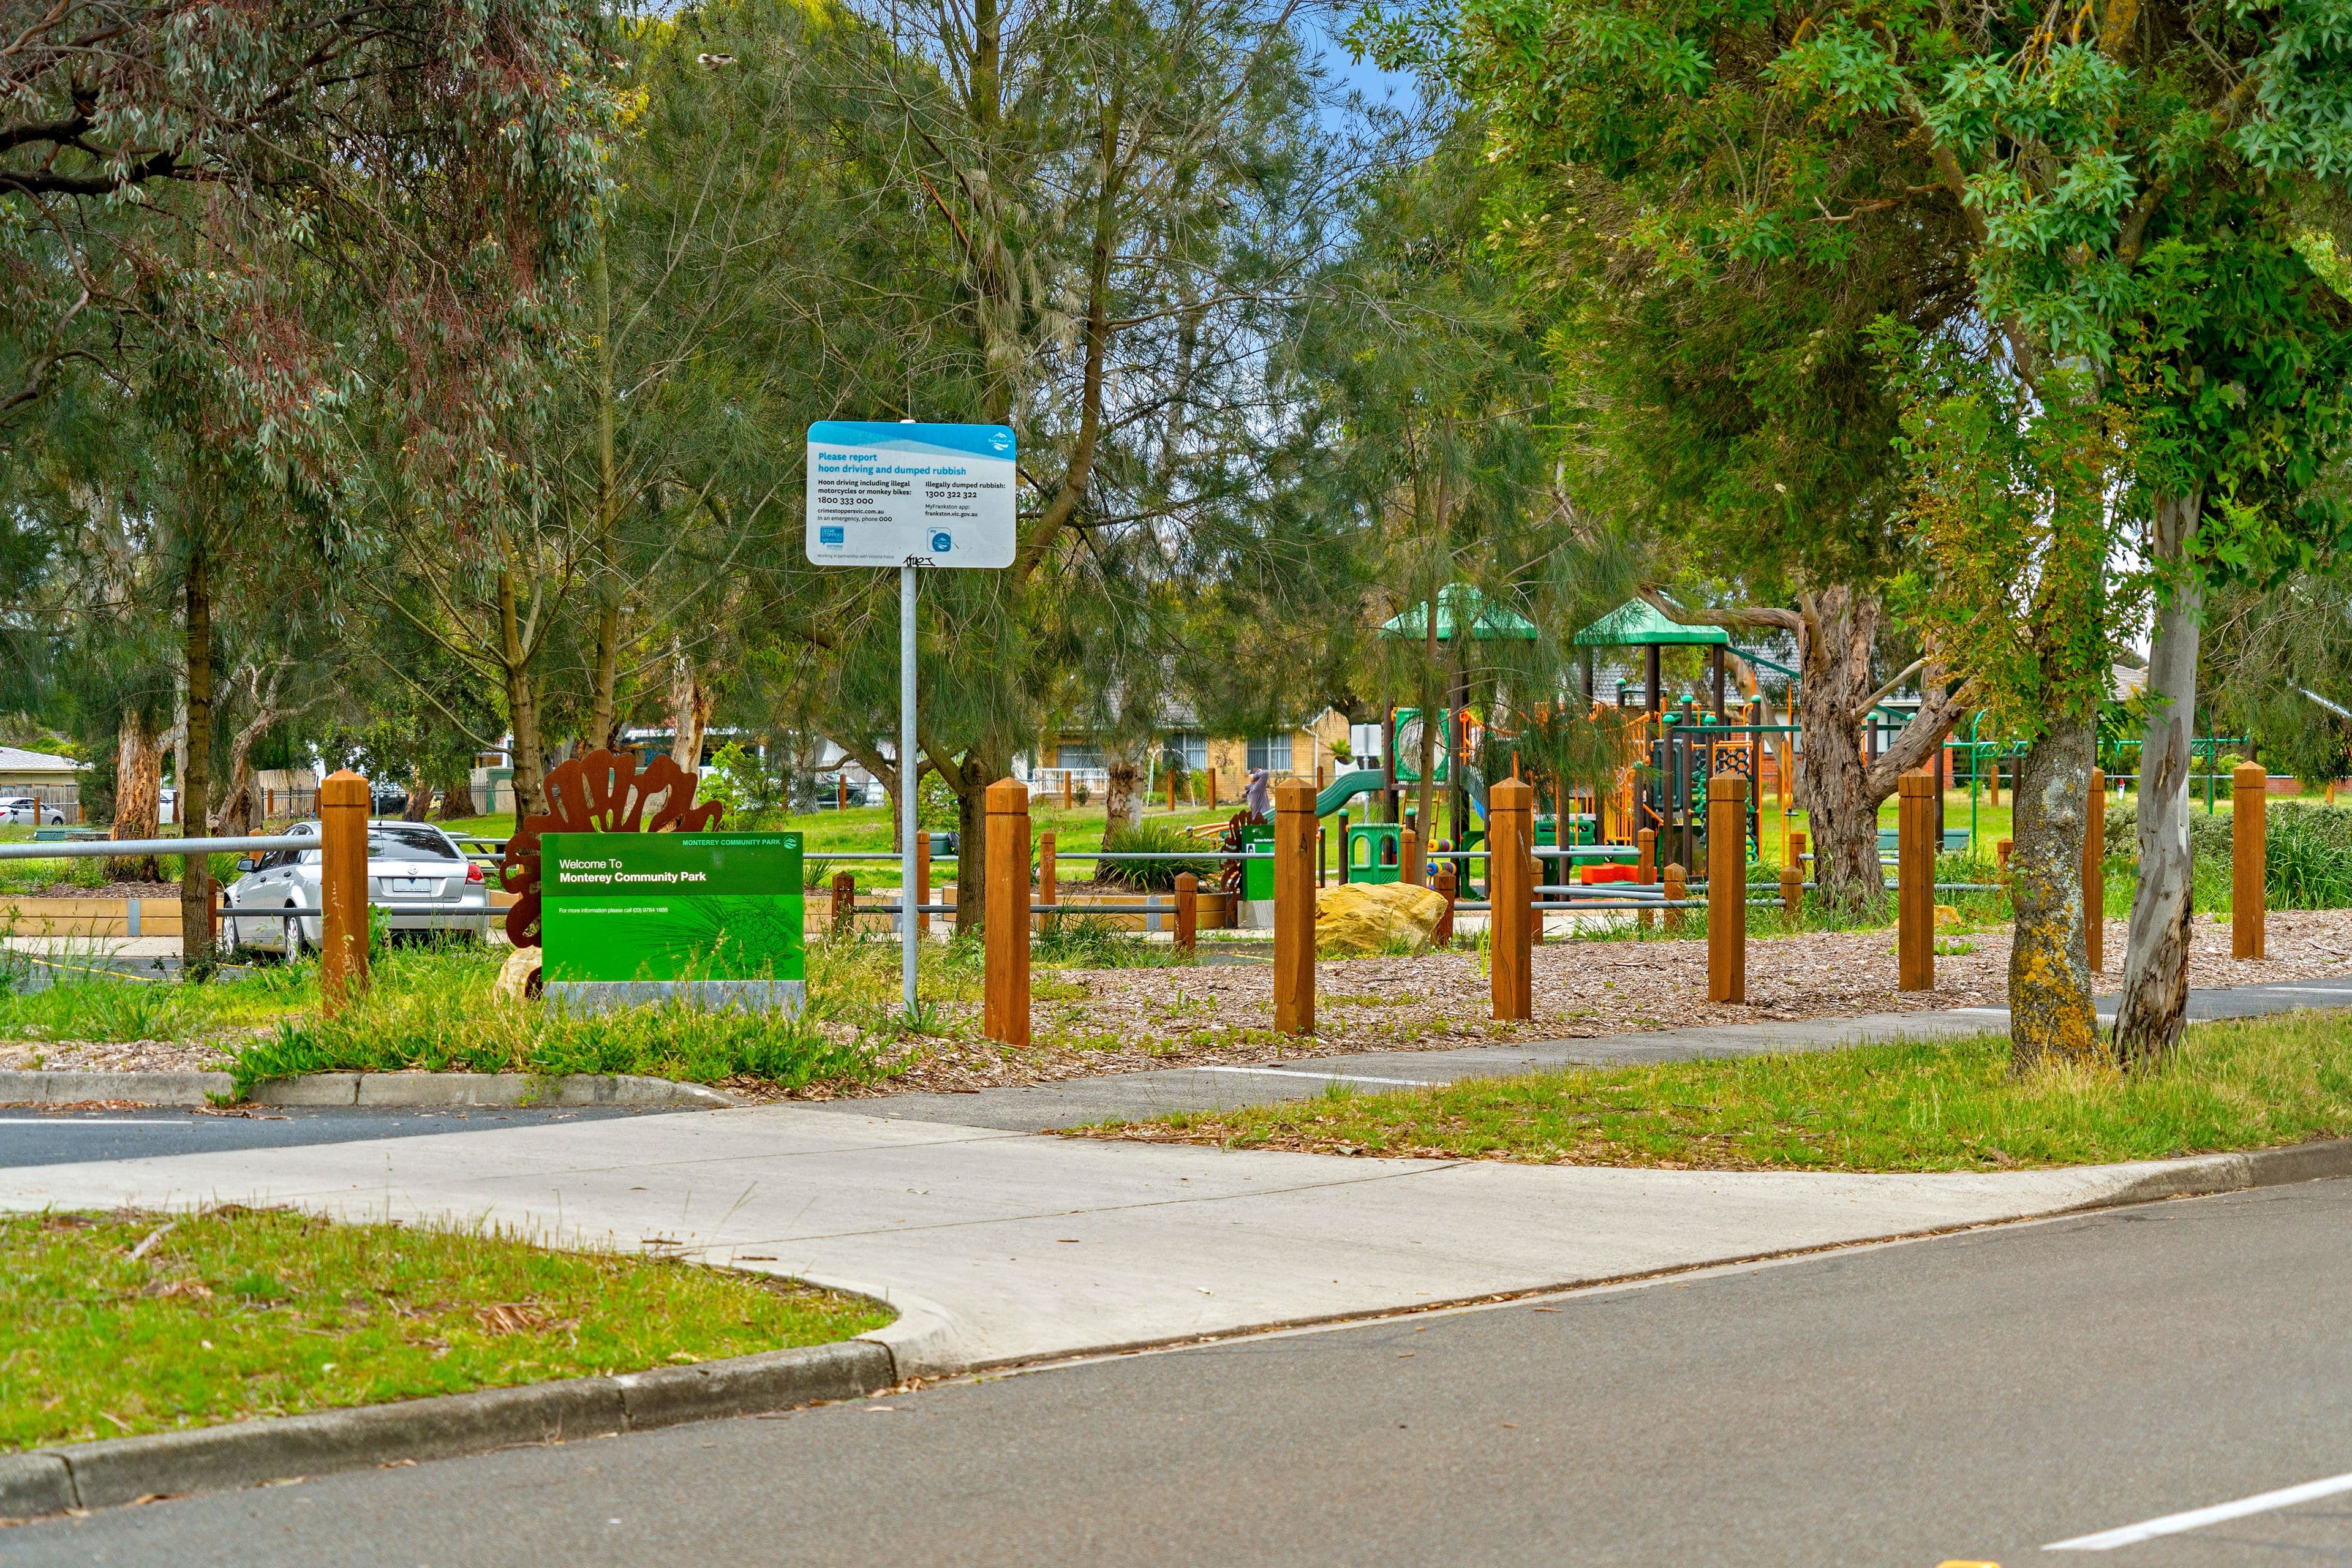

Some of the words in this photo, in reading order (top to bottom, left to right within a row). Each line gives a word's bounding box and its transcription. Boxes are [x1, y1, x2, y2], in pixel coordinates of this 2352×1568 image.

[850, 454, 877, 462] report
[843, 465, 873, 475] driving
[894, 466, 930, 476] dumped
[559, 859, 606, 869] Welcome
[609, 859, 622, 869] To
[560, 872, 612, 884] Monterey
[614, 872, 677, 883] Community
[680, 872, 706, 881] Park
